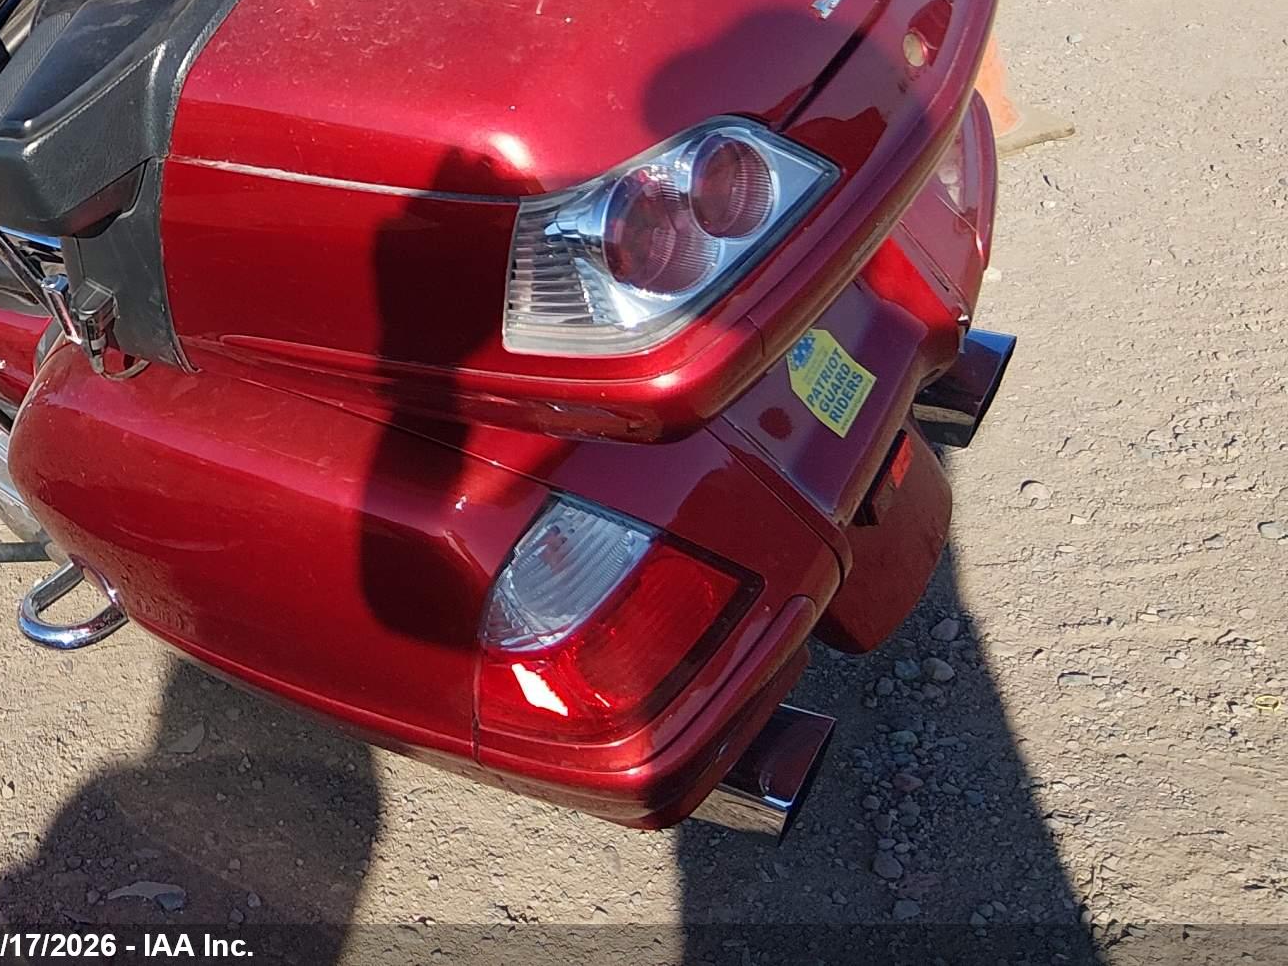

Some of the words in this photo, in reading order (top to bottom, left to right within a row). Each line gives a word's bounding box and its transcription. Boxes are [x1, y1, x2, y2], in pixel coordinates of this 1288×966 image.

[806, 347, 842, 408] PATRIOT
[819, 362, 852, 413] GUARD
[828, 371, 864, 424] RIDERS
